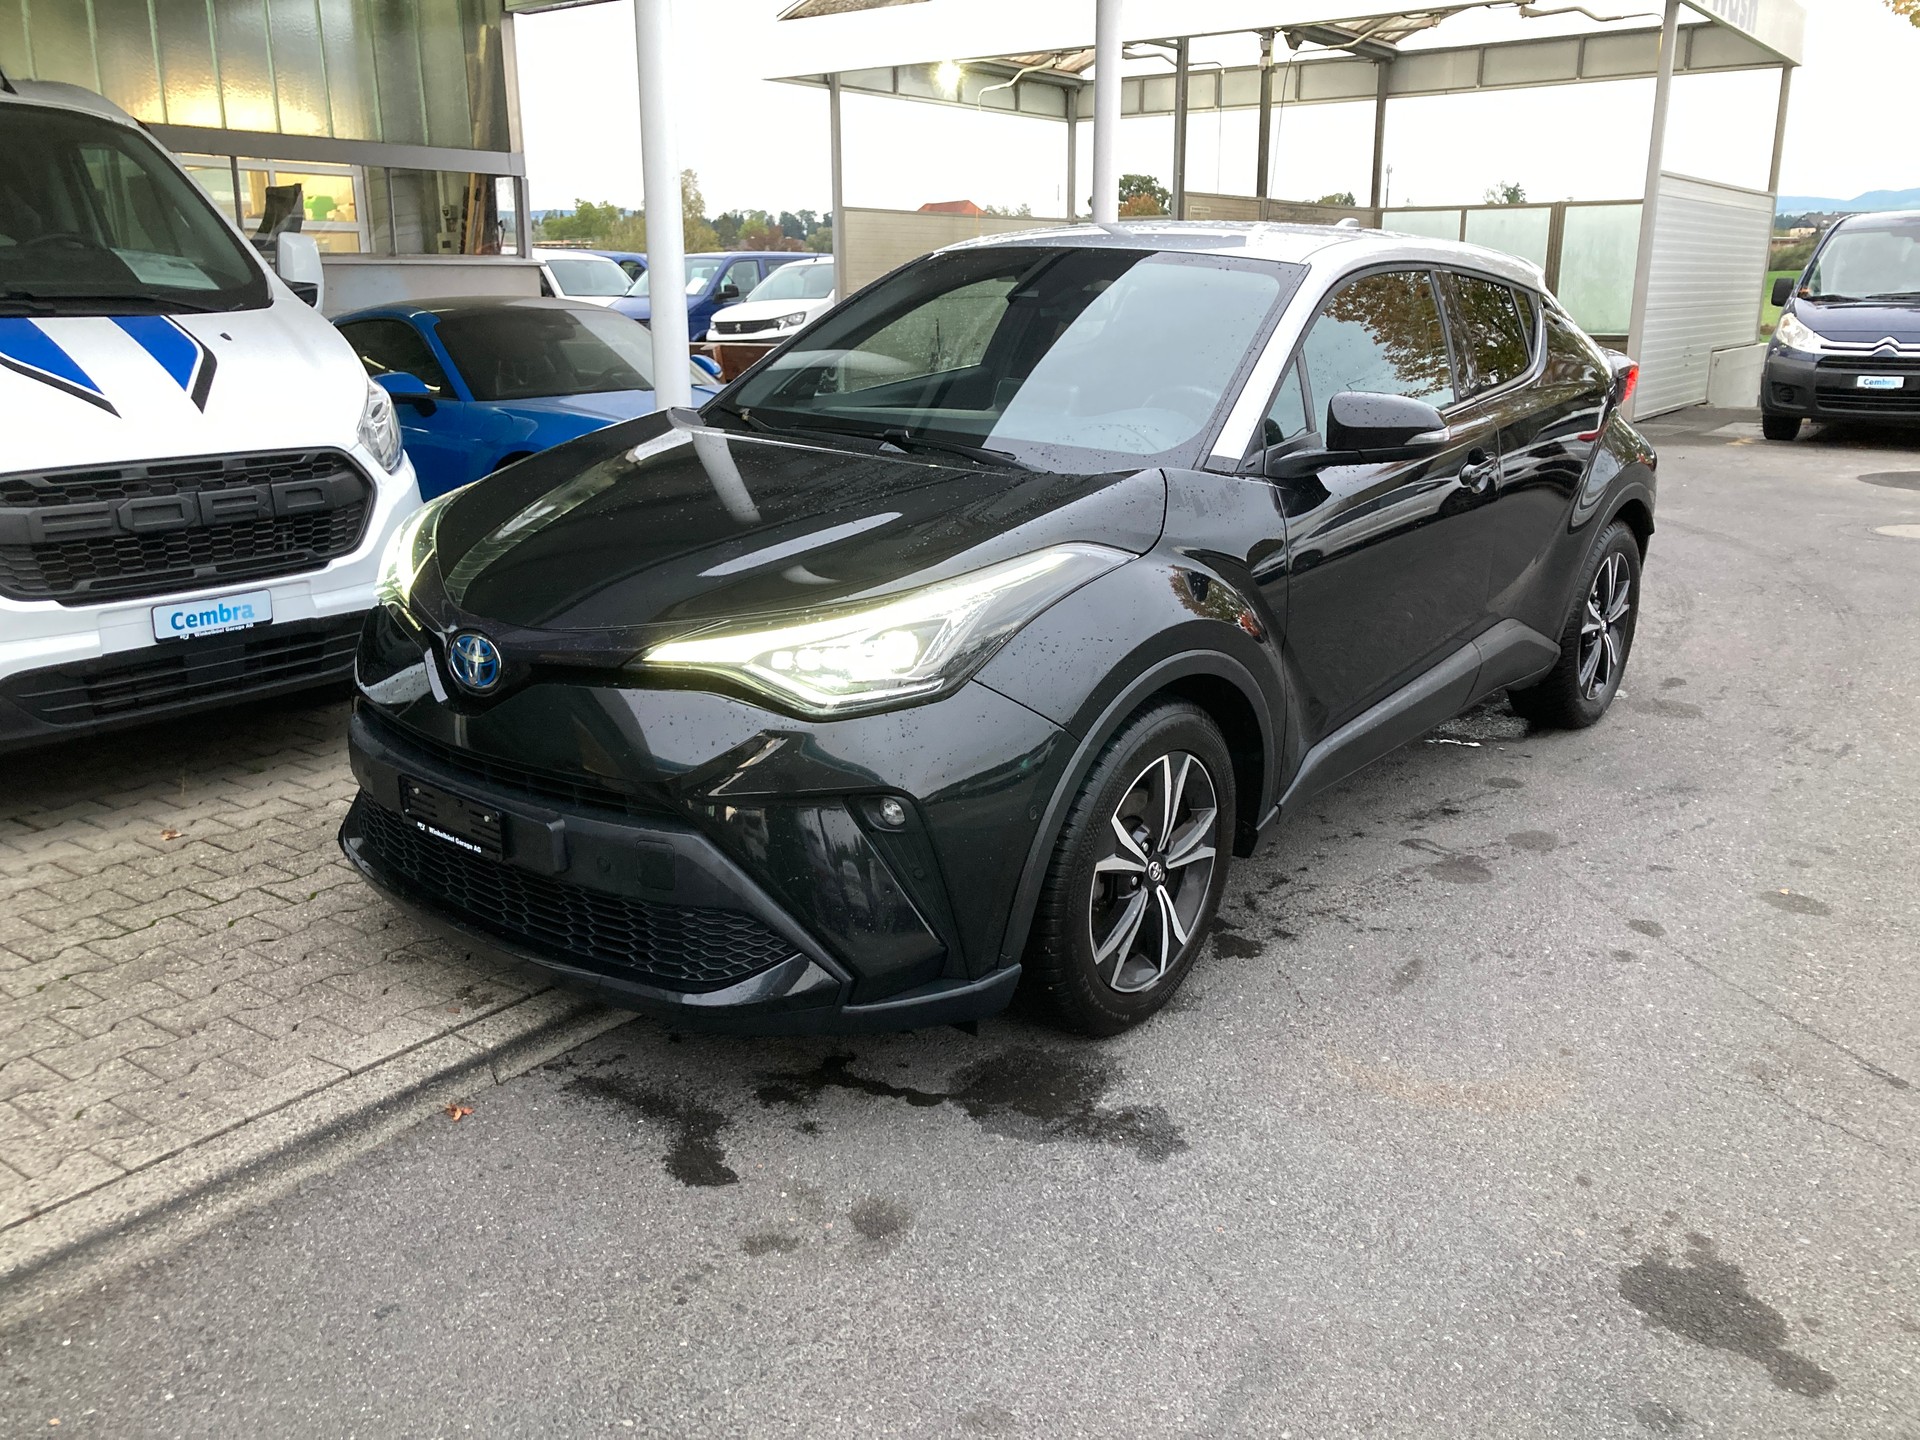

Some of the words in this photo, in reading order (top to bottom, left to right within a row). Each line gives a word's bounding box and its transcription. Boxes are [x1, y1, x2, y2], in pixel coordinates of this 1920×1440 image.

[28, 477, 333, 544] FORD
[170, 603, 255, 631] Cembra
[455, 837, 474, 851] Garage
[473, 844, 482, 853] AG
